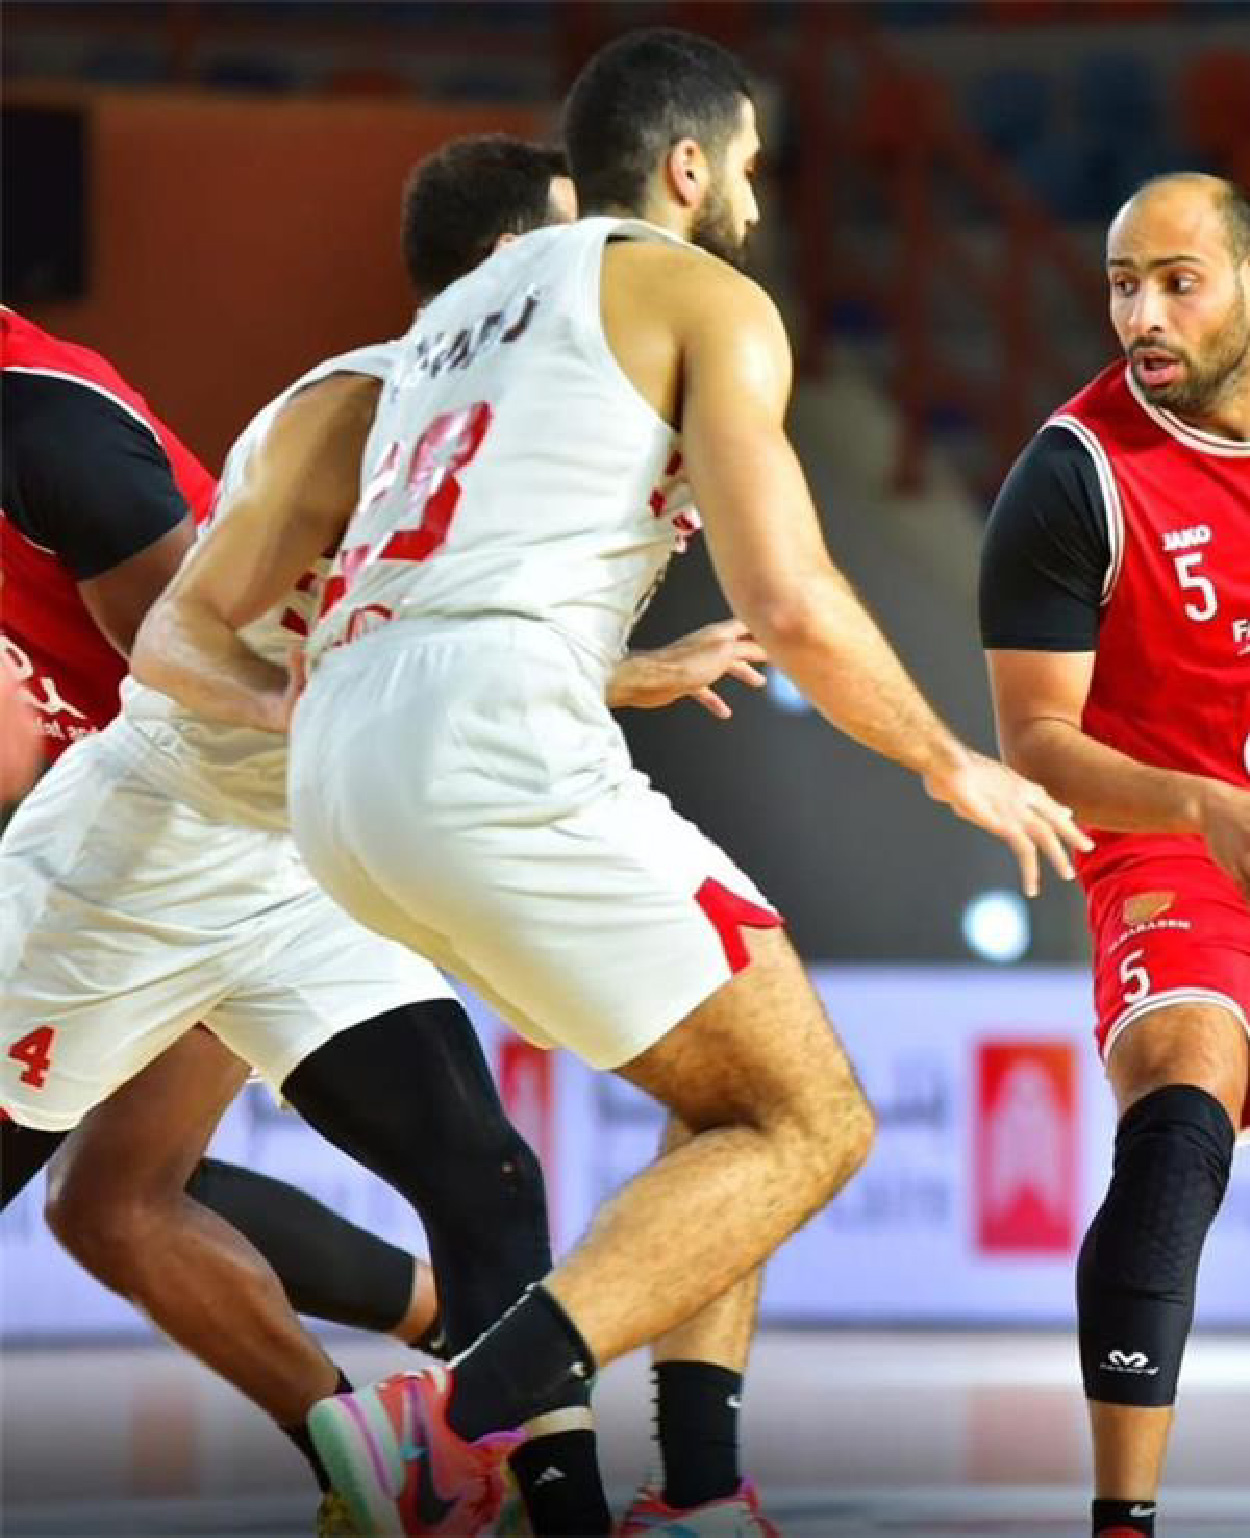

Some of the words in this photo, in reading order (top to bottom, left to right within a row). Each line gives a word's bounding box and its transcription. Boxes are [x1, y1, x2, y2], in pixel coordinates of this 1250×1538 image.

[1174, 552, 1218, 622] 5
[1120, 949, 1151, 1003] 5
[9, 1026, 56, 1089] 4
